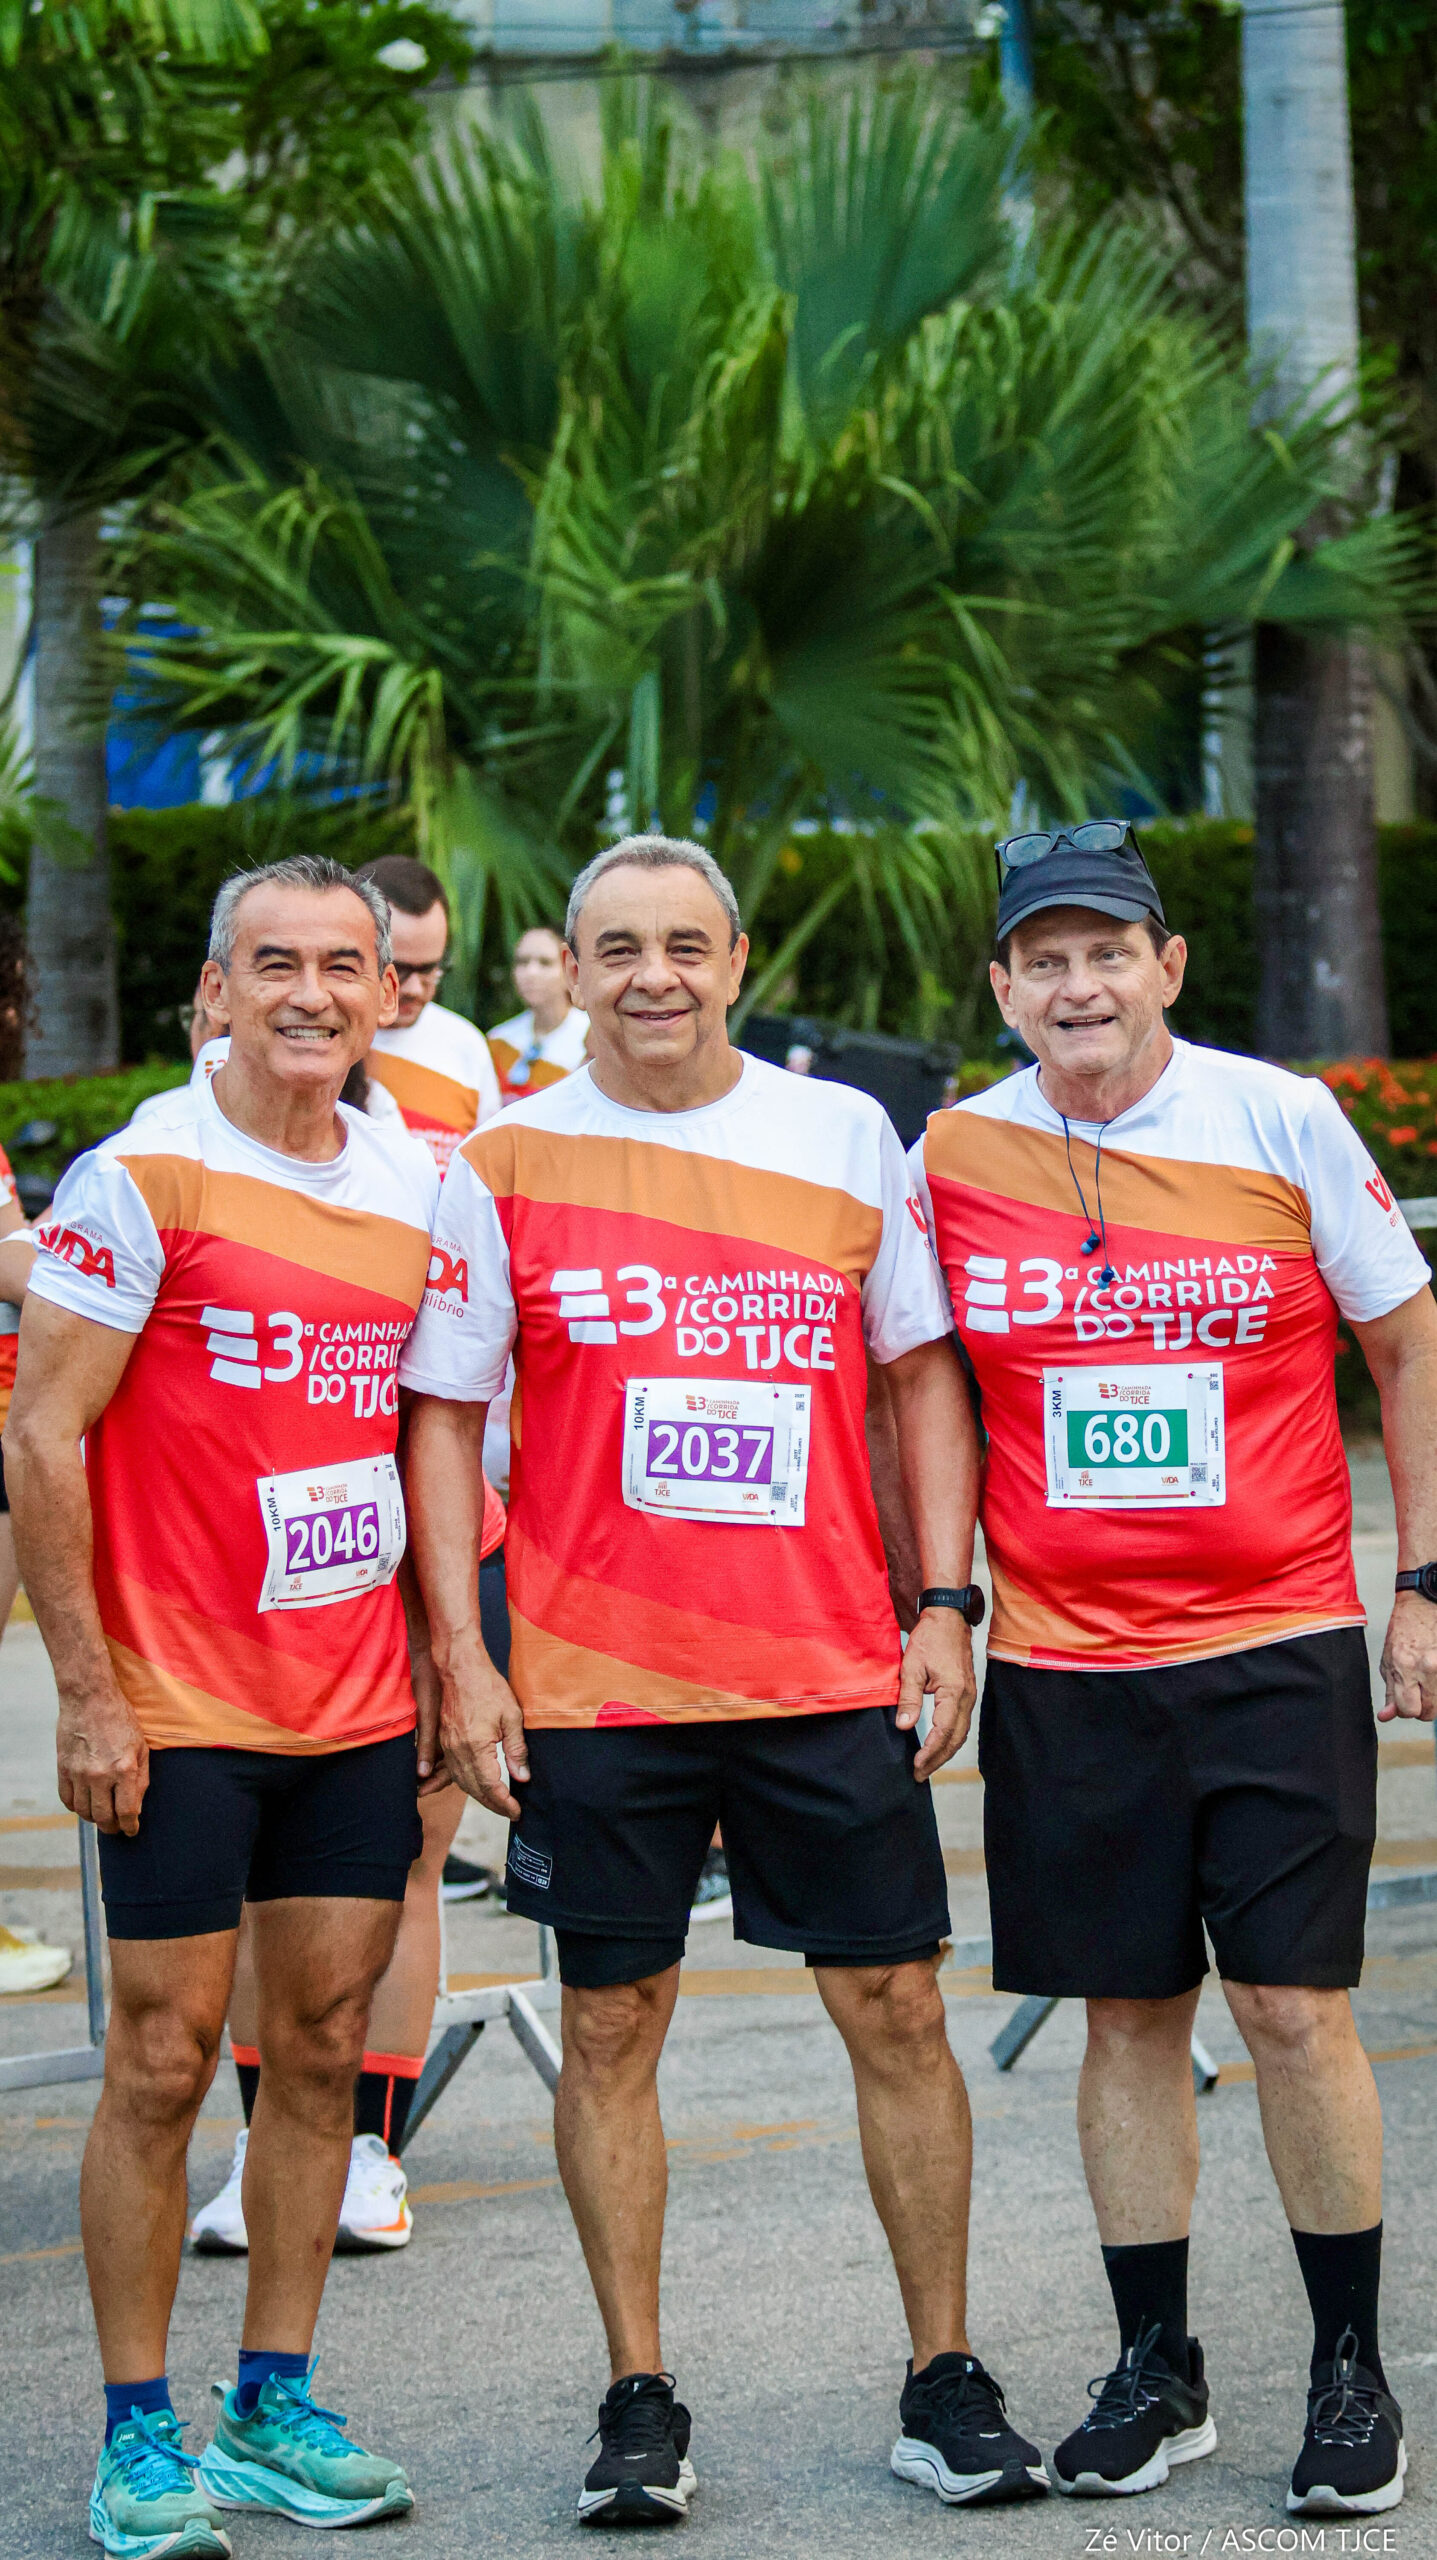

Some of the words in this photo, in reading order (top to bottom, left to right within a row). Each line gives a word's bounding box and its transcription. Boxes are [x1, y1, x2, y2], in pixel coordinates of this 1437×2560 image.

[425, 1245, 469, 1303] DA
[684, 1270, 845, 1297] CAMINHADA
[1087, 1254, 1277, 1285] CAMINHADA
[425, 1291, 464, 1318] ilíbrio
[675, 1294, 836, 1324] /CORRIDA
[1073, 1276, 1274, 1312] /CORRIDA
[1074, 1314, 1135, 1342] DO
[1141, 1305, 1268, 1350] TJCE
[676, 1326, 730, 1356] DO
[735, 1324, 835, 1371] TJCE
[308, 1374, 346, 1404] DO
[1052, 1390, 1062, 1418] 3KM
[1130, 1395, 1150, 1405] TJCE
[633, 1396, 645, 1431] 10KM
[718, 1410, 738, 1420] TJCE
[650, 1424, 772, 1479] 2037
[1084, 1412, 1171, 1463] 680
[654, 1488, 671, 1497] TJCE
[1078, 1478, 1094, 1486] TJCE
[333, 1493, 348, 1504] TJCE
[267, 1497, 282, 1532] 10KM
[288, 1506, 378, 1570] 2046
[289, 1583, 303, 1591] TJCE
